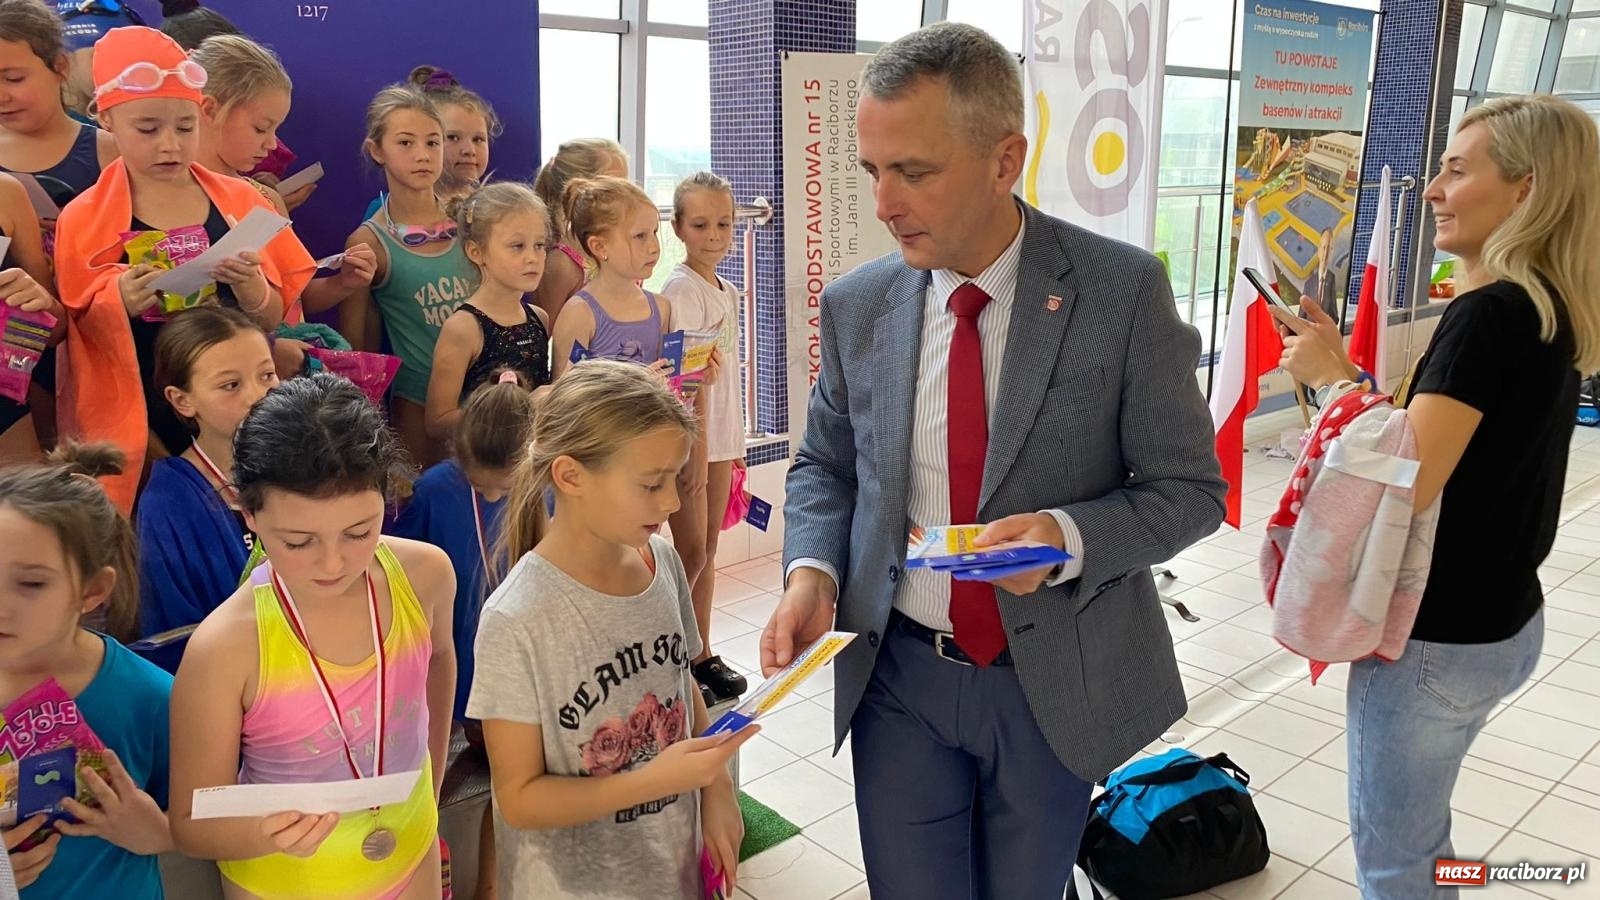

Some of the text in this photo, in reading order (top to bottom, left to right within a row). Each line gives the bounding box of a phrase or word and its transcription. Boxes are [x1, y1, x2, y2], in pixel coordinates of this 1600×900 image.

[296, 5, 329, 21] 1217
[1255, 4, 1320, 25] Czas na inwestycje
[1275, 51, 1338, 70] TU POWSTAJE
[804, 79, 821, 103] 15
[1254, 75, 1353, 97] Zewnętrzny kompleks
[808, 112, 821, 134] nr
[827, 79, 840, 155] Raciborzu
[1262, 102, 1343, 122] basenów i atrakcji
[830, 160, 840, 173] w
[844, 79, 860, 255] im. Jana III Sobieskiego
[806, 141, 823, 308] PODSTAWOWA
[828, 178, 842, 268] Sportowymi
[559, 641, 648, 730] GLAM
